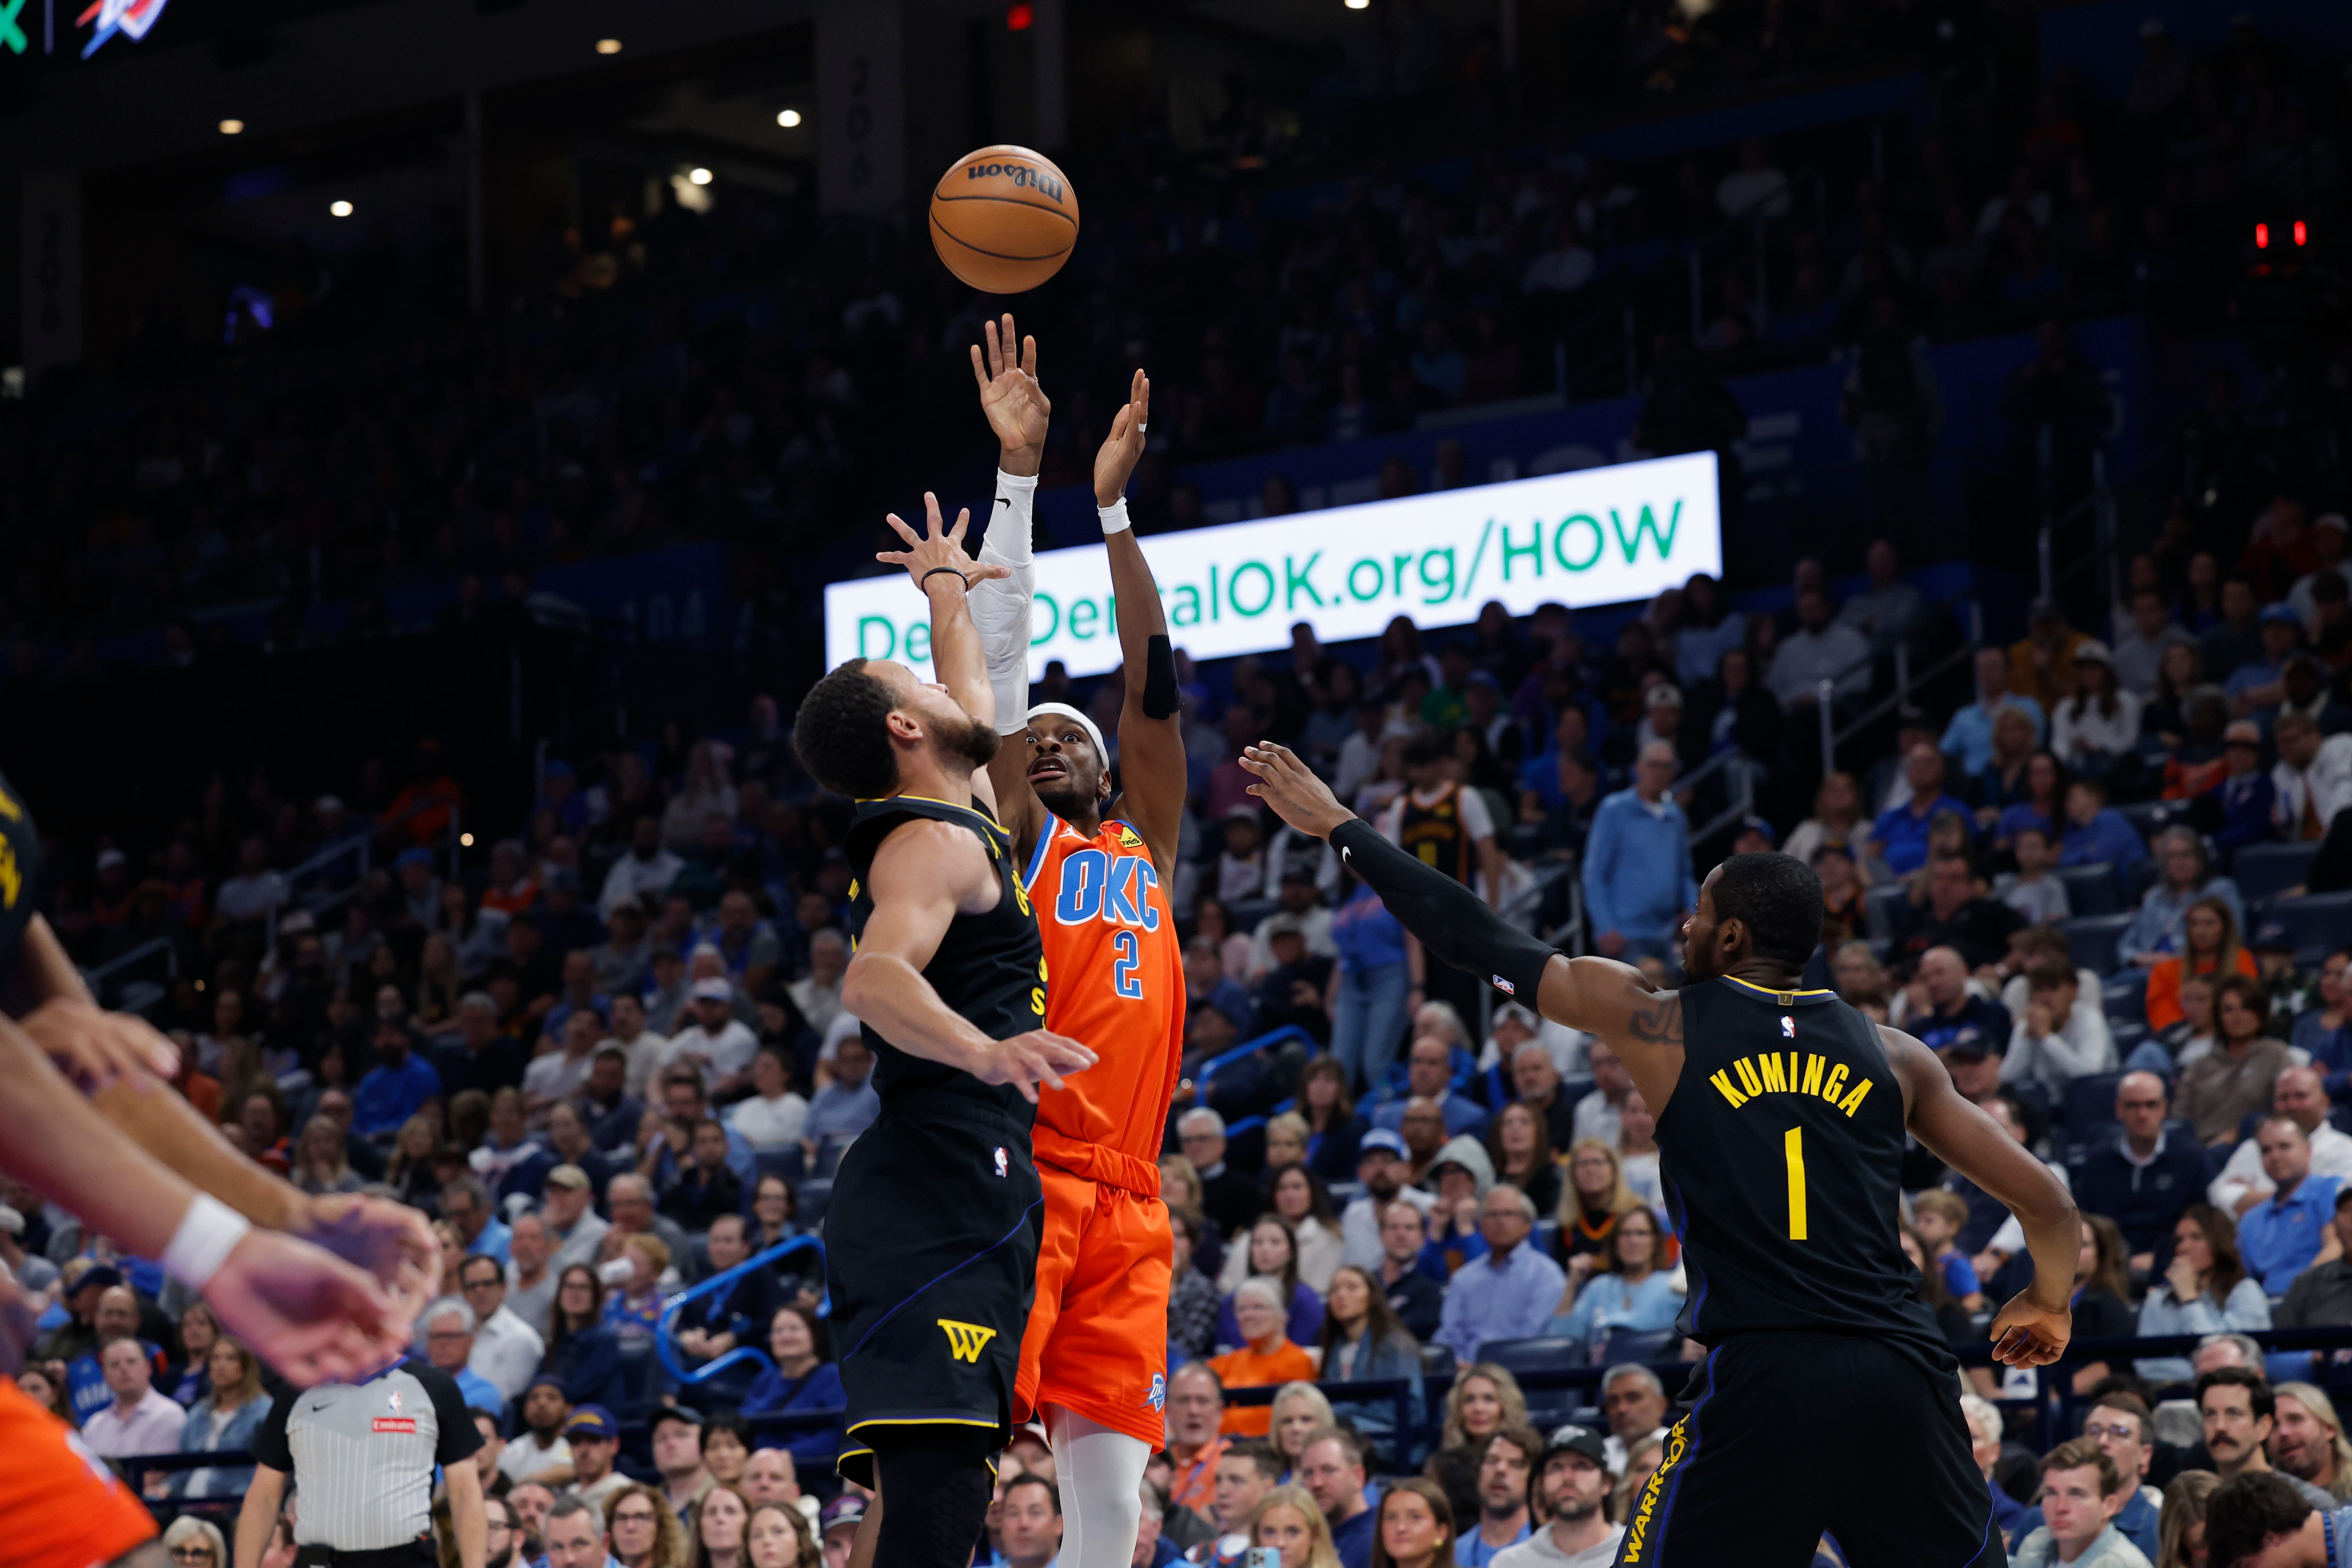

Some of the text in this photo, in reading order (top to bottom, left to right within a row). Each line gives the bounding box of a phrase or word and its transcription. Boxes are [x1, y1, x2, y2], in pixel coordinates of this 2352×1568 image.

[967, 163, 1063, 205] Wilson
[1055, 849, 1159, 933] OKC
[1114, 929, 1143, 1000] 2
[1709, 1051, 1874, 1118] KUMINGA
[1784, 1125, 1808, 1241] 1
[1624, 1412, 1691, 1563] WARRIOR
